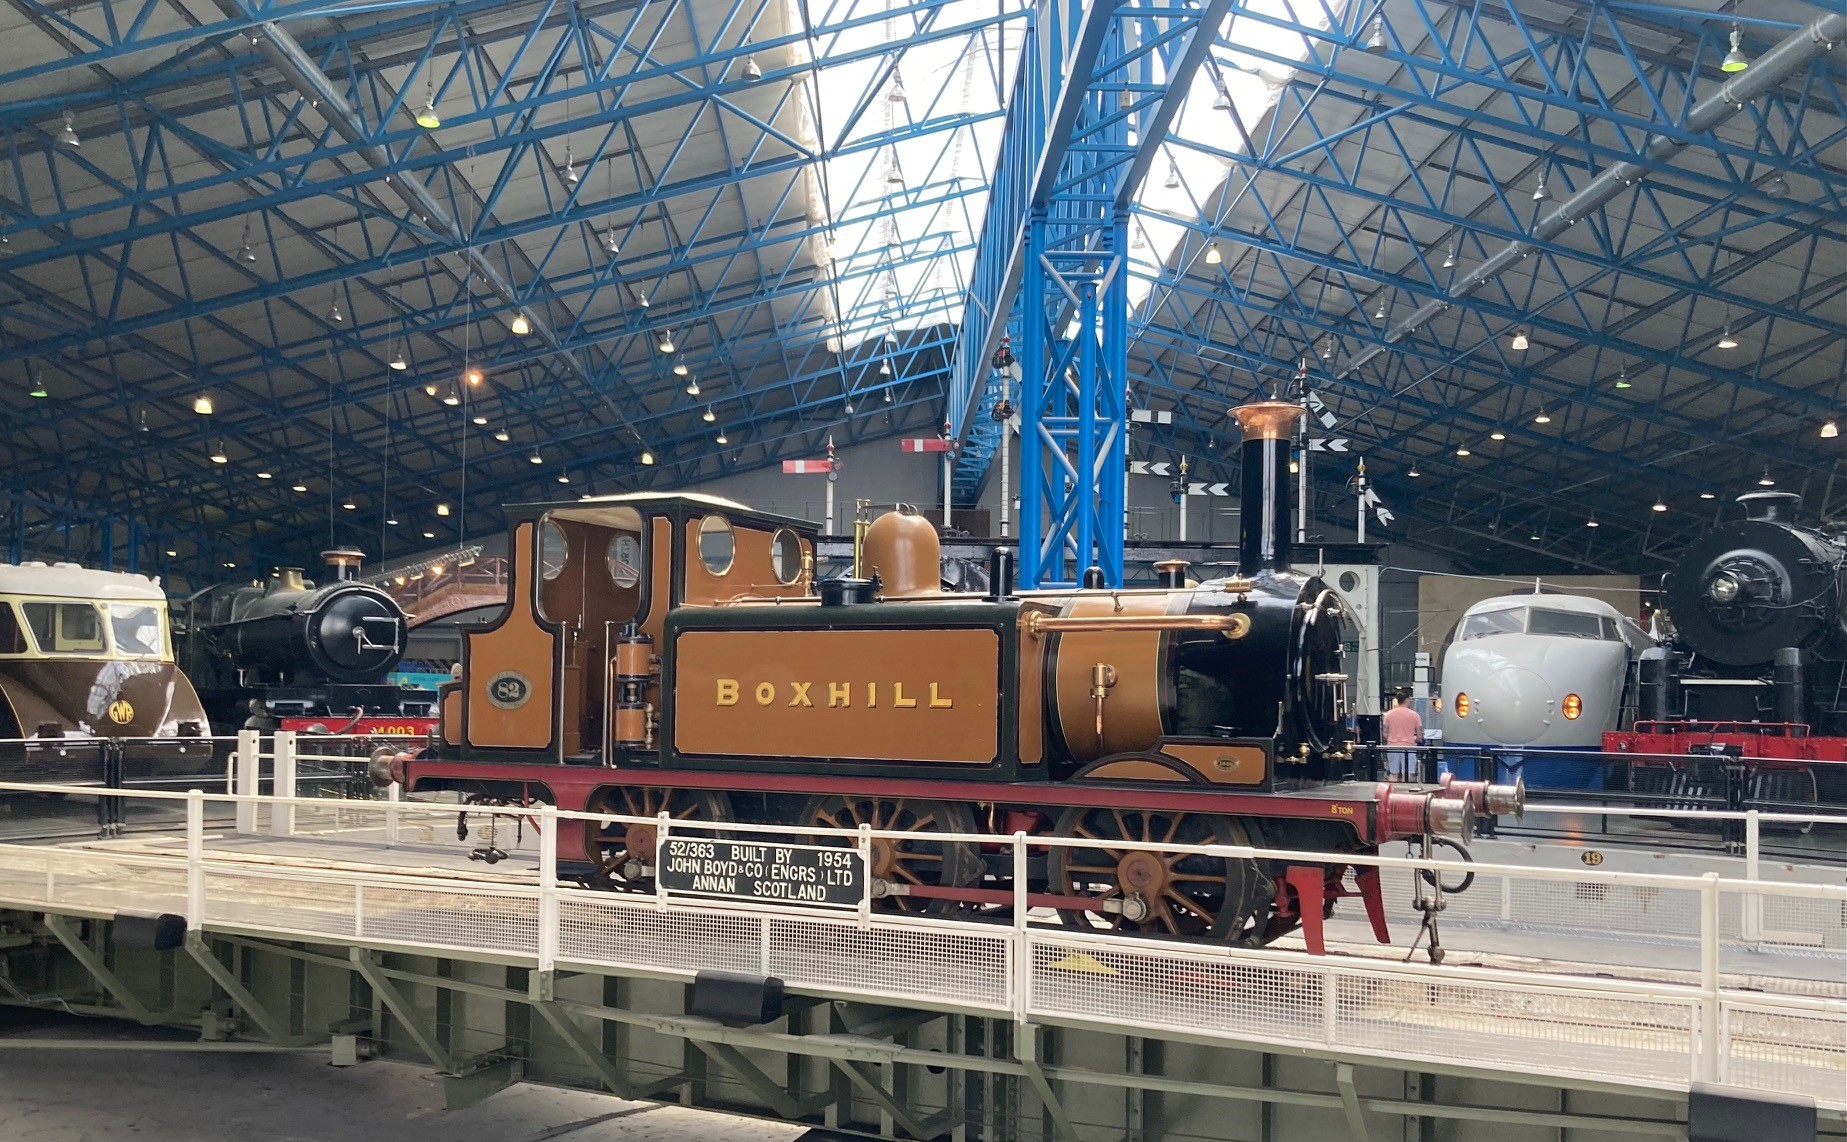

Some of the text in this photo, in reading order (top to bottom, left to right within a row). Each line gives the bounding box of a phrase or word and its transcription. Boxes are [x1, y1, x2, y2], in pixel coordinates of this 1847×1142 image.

[497, 681, 520, 698] 82
[716, 679, 953, 708] BOXHILL
[110, 702, 133, 722] GWR
[378, 726, 415, 736] 4003
[669, 841, 852, 869] 52/363 BUILT BY 1954
[1585, 852, 1601, 865] 19
[667, 857, 700, 874] JOHN
[827, 870, 853, 886] LTD
[692, 875, 826, 901] ANNAN SCOTLAND
